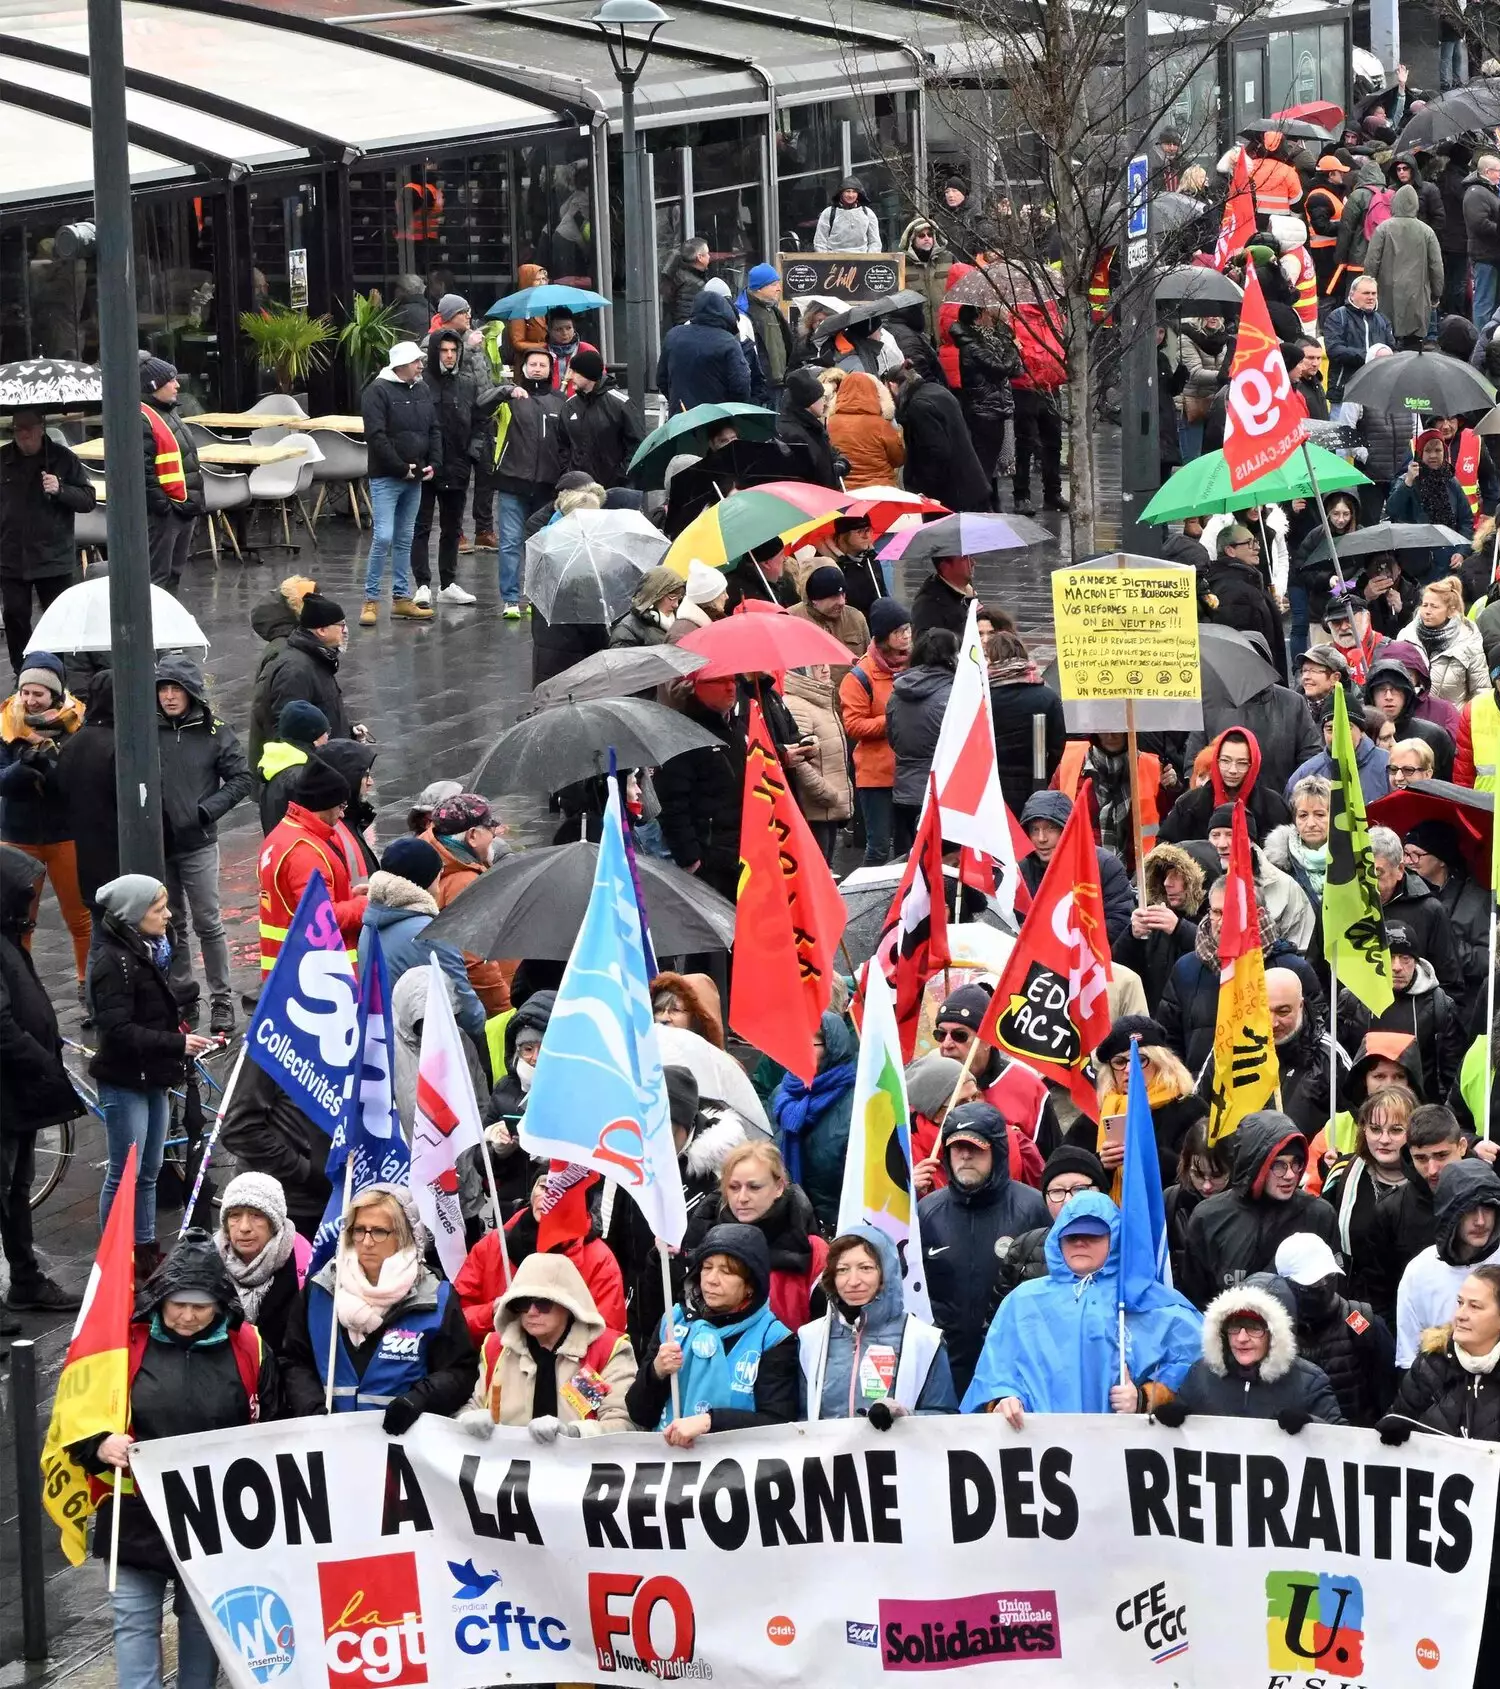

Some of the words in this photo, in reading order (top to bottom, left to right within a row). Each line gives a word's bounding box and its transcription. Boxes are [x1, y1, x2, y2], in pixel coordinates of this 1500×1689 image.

[1064, 587, 1107, 600] MACRON
[1109, 588, 1120, 599] ET
[1123, 588, 1139, 599] TES
[1084, 604, 1127, 615] REFORMES
[1143, 605, 1155, 614] LA
[1158, 605, 1179, 615] CON
[1082, 617, 1097, 627] ON
[1101, 618, 1114, 627] EN
[1120, 619, 1147, 628] VEUT
[1149, 620, 1167, 629] PAS
[1077, 688, 1089, 696] UN
[1147, 688, 1159, 696] EN
[254, 1017, 343, 1119] Collectivités
[160, 1450, 333, 1562] NON
[381, 1442, 434, 1537] A
[457, 1454, 546, 1546] LA
[587, 1448, 904, 1552] REFORME
[946, 1445, 1080, 1544] DES
[1123, 1446, 1476, 1574] RETRAITES
[451, 1602, 489, 1613] Syndicat
[998, 1598, 1033, 1613] Union
[999, 1609, 1053, 1627] syndicale
[1115, 1579, 1167, 1632] CFE
[325, 1611, 428, 1683] cgt
[454, 1601, 572, 1655] cftc
[587, 1572, 696, 1681] FO
[885, 1614, 1056, 1665] Solidaires
[1143, 1604, 1188, 1651] CGC
[598, 1646, 613, 1669] la
[615, 1649, 649, 1674] force
[650, 1656, 713, 1681] syndicale
